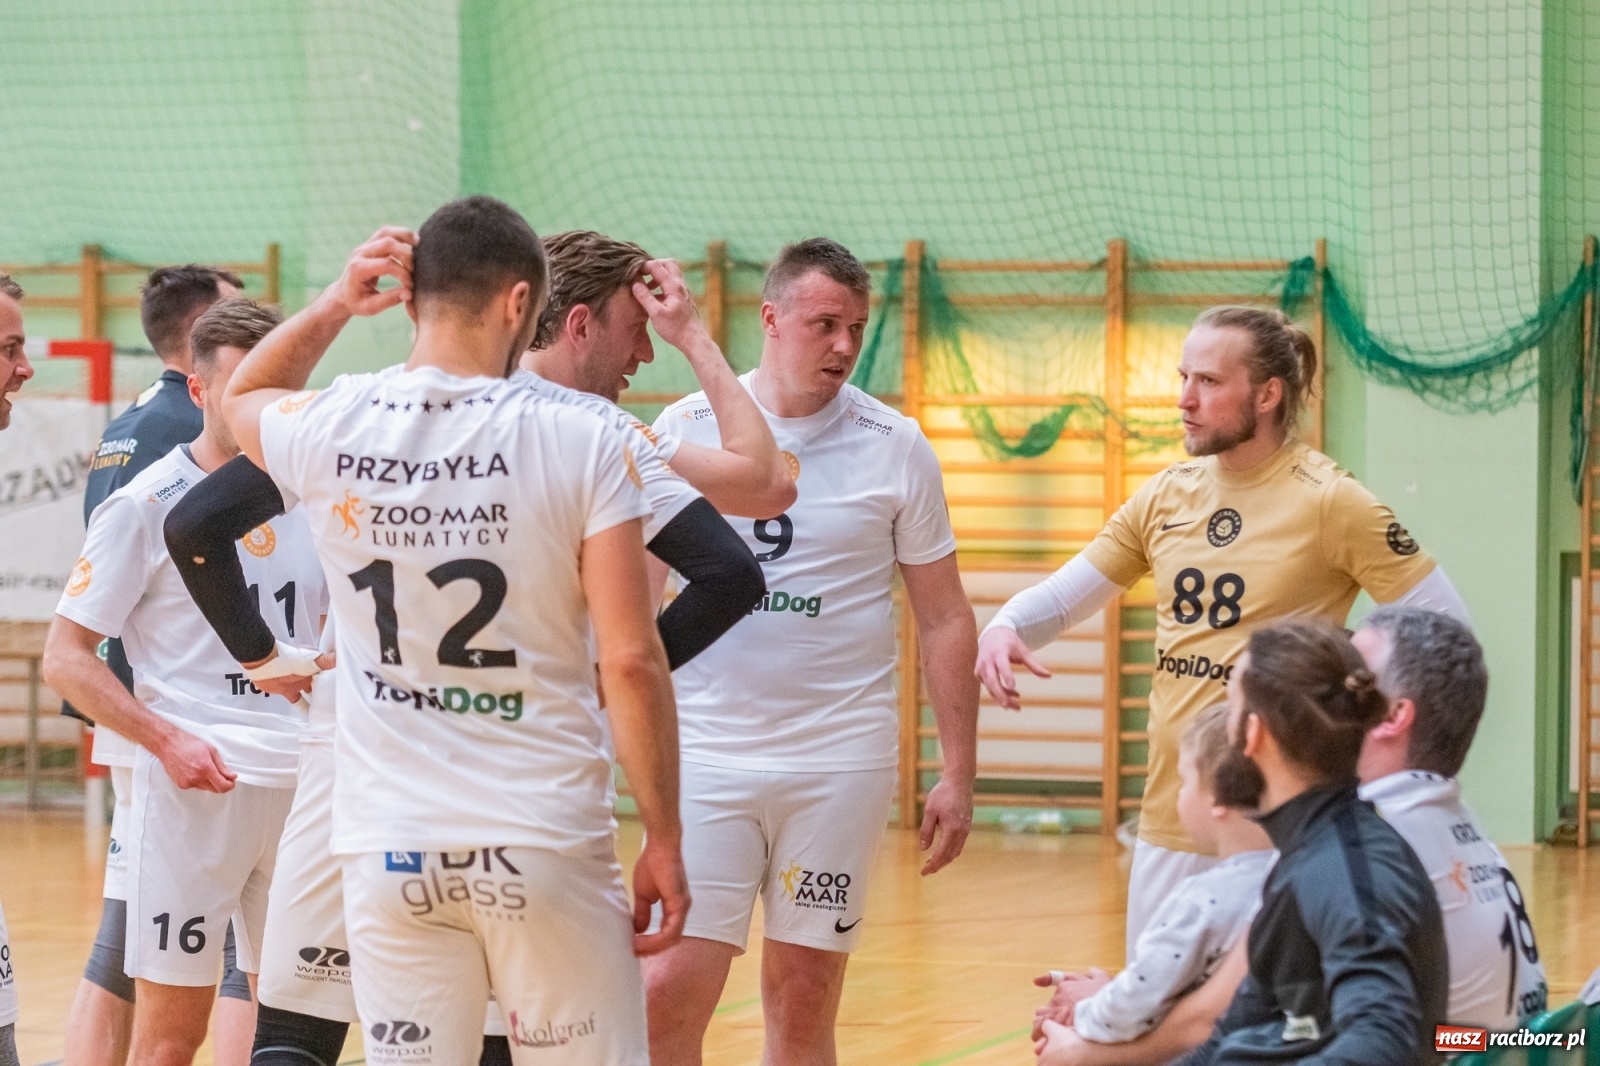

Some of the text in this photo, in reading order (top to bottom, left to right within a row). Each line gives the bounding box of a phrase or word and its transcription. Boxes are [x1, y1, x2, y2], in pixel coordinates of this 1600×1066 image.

[336, 453, 510, 485] PRZYBYŁA
[370, 503, 509, 526] ZOO-MAR
[372, 527, 509, 548] LUNATYCY
[753, 512, 794, 563] 9
[348, 558, 517, 669] 12
[1171, 568, 1245, 630] 88
[225, 673, 270, 698] Tro
[401, 867, 527, 917] glass
[795, 886, 848, 905] MAR
[801, 870, 852, 889] ZOO
[795, 901, 848, 912] sklep zoologiczny
[152, 912, 207, 955] 16
[1498, 867, 1539, 1017] 18
[294, 972, 329, 982] PRODUCENT
[520, 1011, 595, 1046] kolgraf
